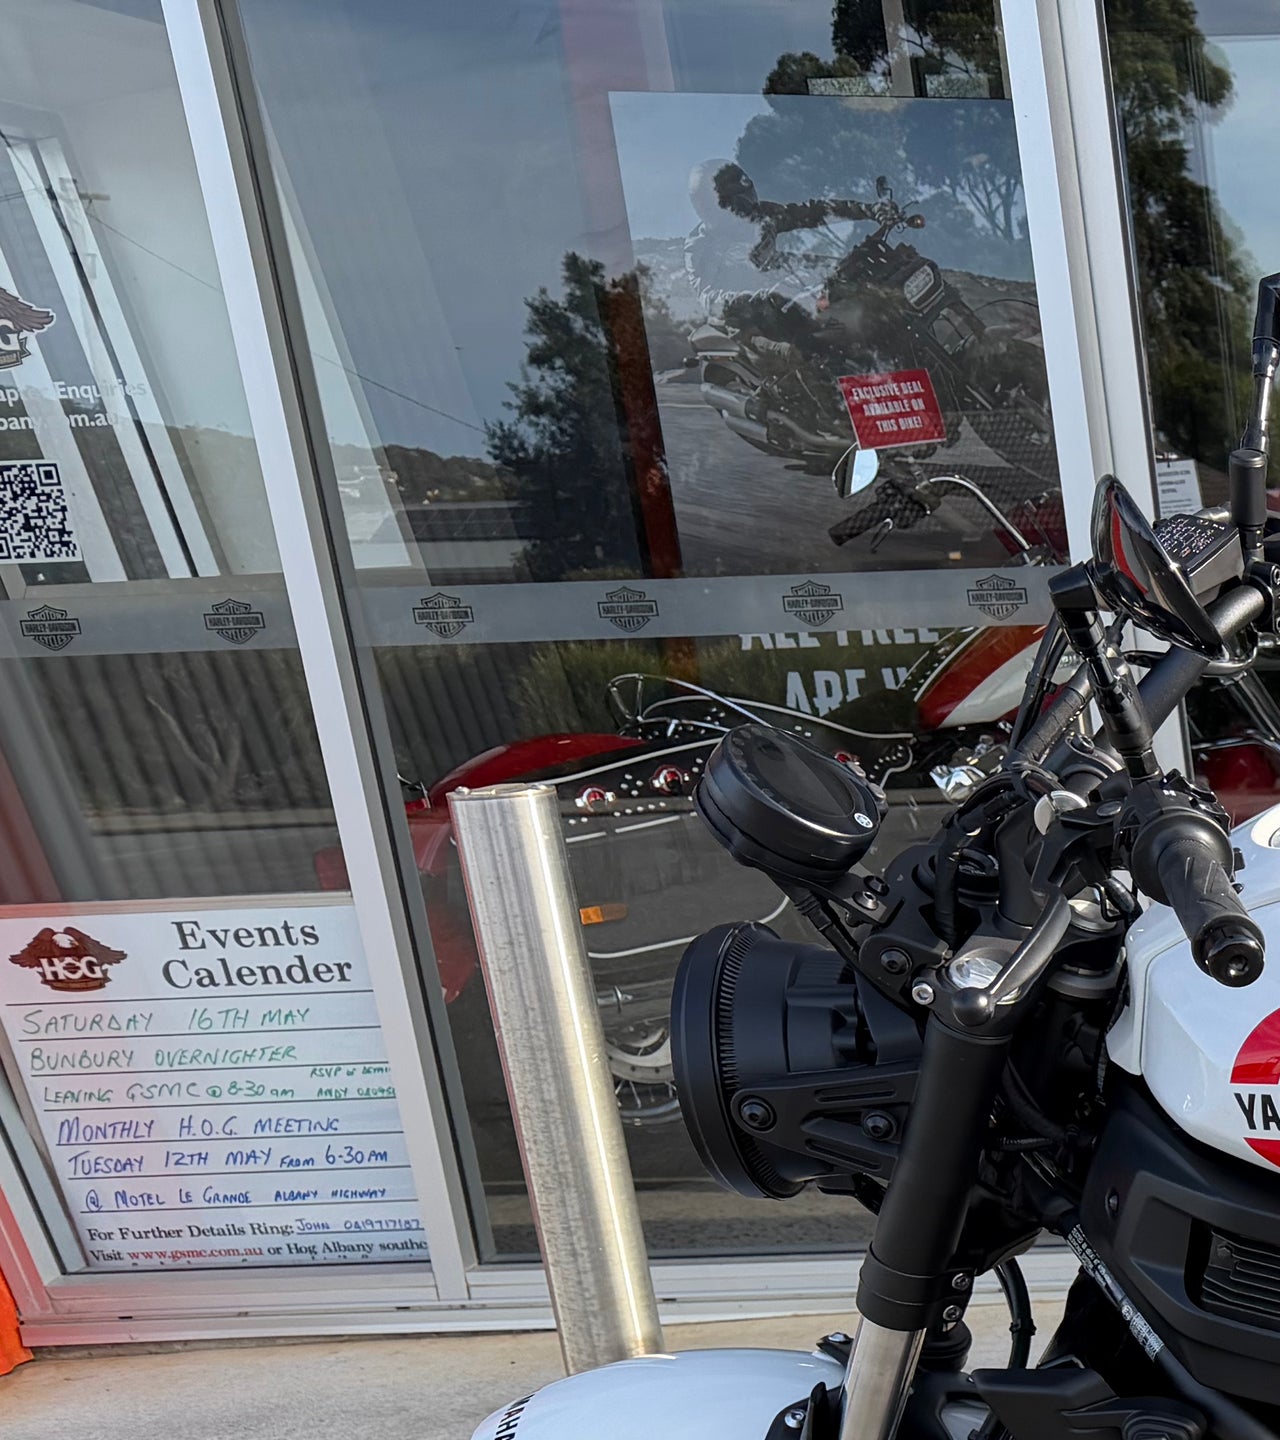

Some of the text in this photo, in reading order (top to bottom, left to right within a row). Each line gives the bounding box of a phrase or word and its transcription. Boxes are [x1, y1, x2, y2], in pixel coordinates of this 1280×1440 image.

[54, 379, 147, 403] Enquiries
[852, 381, 925, 399] EXCLUSIVE DEAL
[863, 398, 925, 416] AVAILABLE ON
[876, 416, 923, 432] THIS BIKE!
[787, 598, 839, 609] HARLEY-DAVIDSON
[25, 622, 77, 633] HARLEY-DAVIDSON
[208, 615, 261, 627] HARLEY-DAVIDSON
[171, 920, 320, 950] Events
[39, 956, 103, 980] HOG
[162, 955, 352, 989] Calender
[22, 1010, 153, 1034] SATURDAY
[261, 1008, 310, 1026] MAY
[31, 1046, 298, 1071] BUNBURY OVERNIGHTER
[310, 1066, 342, 1078] RSVP
[44, 1087, 113, 1103] LEAVING
[127, 1082, 201, 1102] GSMC
[317, 1088, 348, 1099] ANDY
[58, 1114, 339, 1144] MONTHLY H.O.G. MEETING
[68, 1150, 144, 1176] TUESDAY
[165, 1150, 209, 1168] 12TH
[225, 1147, 272, 1166] MAY
[279, 1155, 315, 1168] FROM
[115, 1190, 166, 1209] MOTEL
[179, 1188, 192, 1204] LE
[203, 1186, 252, 1204] GRANDE
[274, 1189, 318, 1202] ALBANY
[331, 1188, 386, 1199] HIGHWAY
[87, 1222, 295, 1241] For Further Details Ring:
[295, 1218, 330, 1232] JOHN
[90, 1250, 124, 1262] Visit
[127, 1247, 263, 1262] www.gsmc.com.au
[267, 1245, 282, 1255] or
[286, 1242, 316, 1257] Hog
[322, 1241, 374, 1254] Albany
